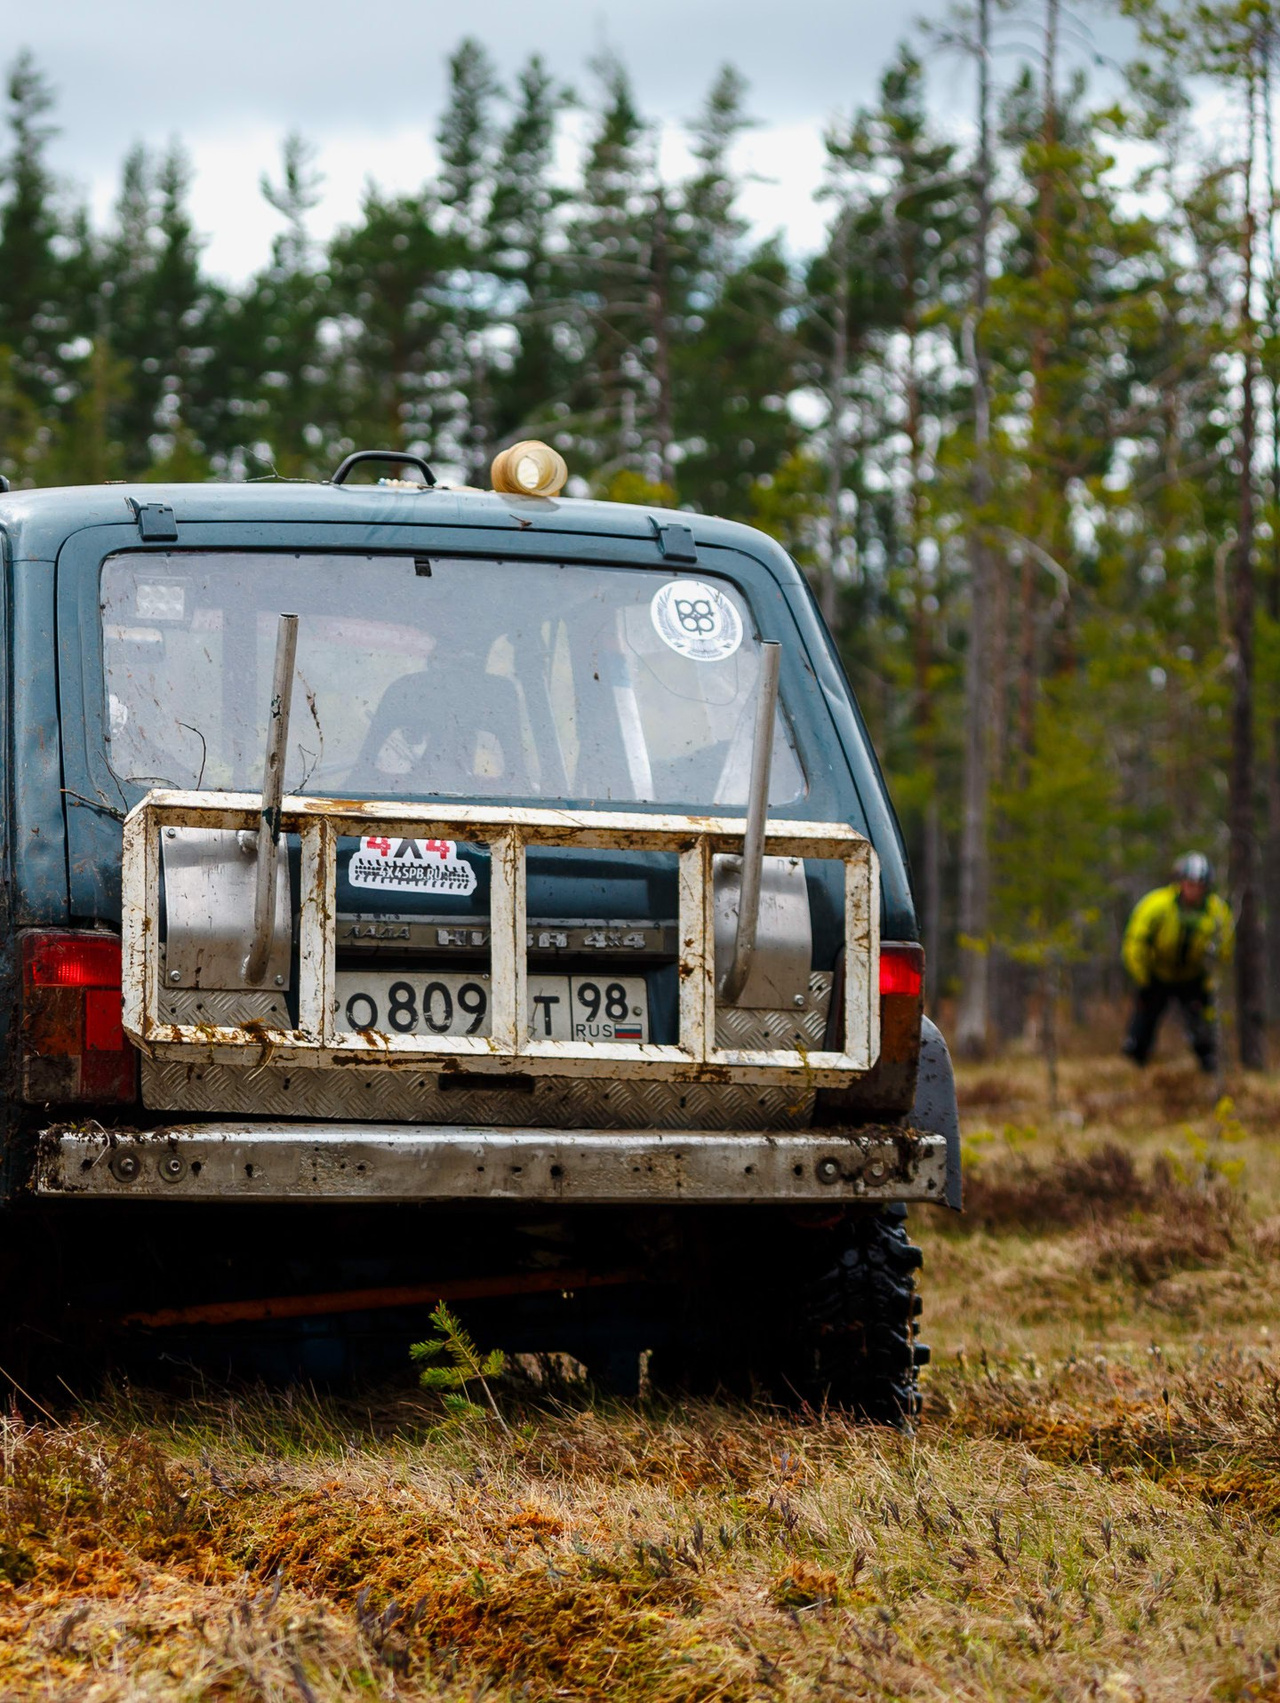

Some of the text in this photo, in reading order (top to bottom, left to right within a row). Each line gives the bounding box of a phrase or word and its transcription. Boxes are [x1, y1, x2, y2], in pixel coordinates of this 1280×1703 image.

[379, 866, 443, 881] 4X4SPB.RU
[436, 928, 568, 948] НИА
[577, 981, 629, 1022] 98
[575, 1022, 613, 1038] RUS
